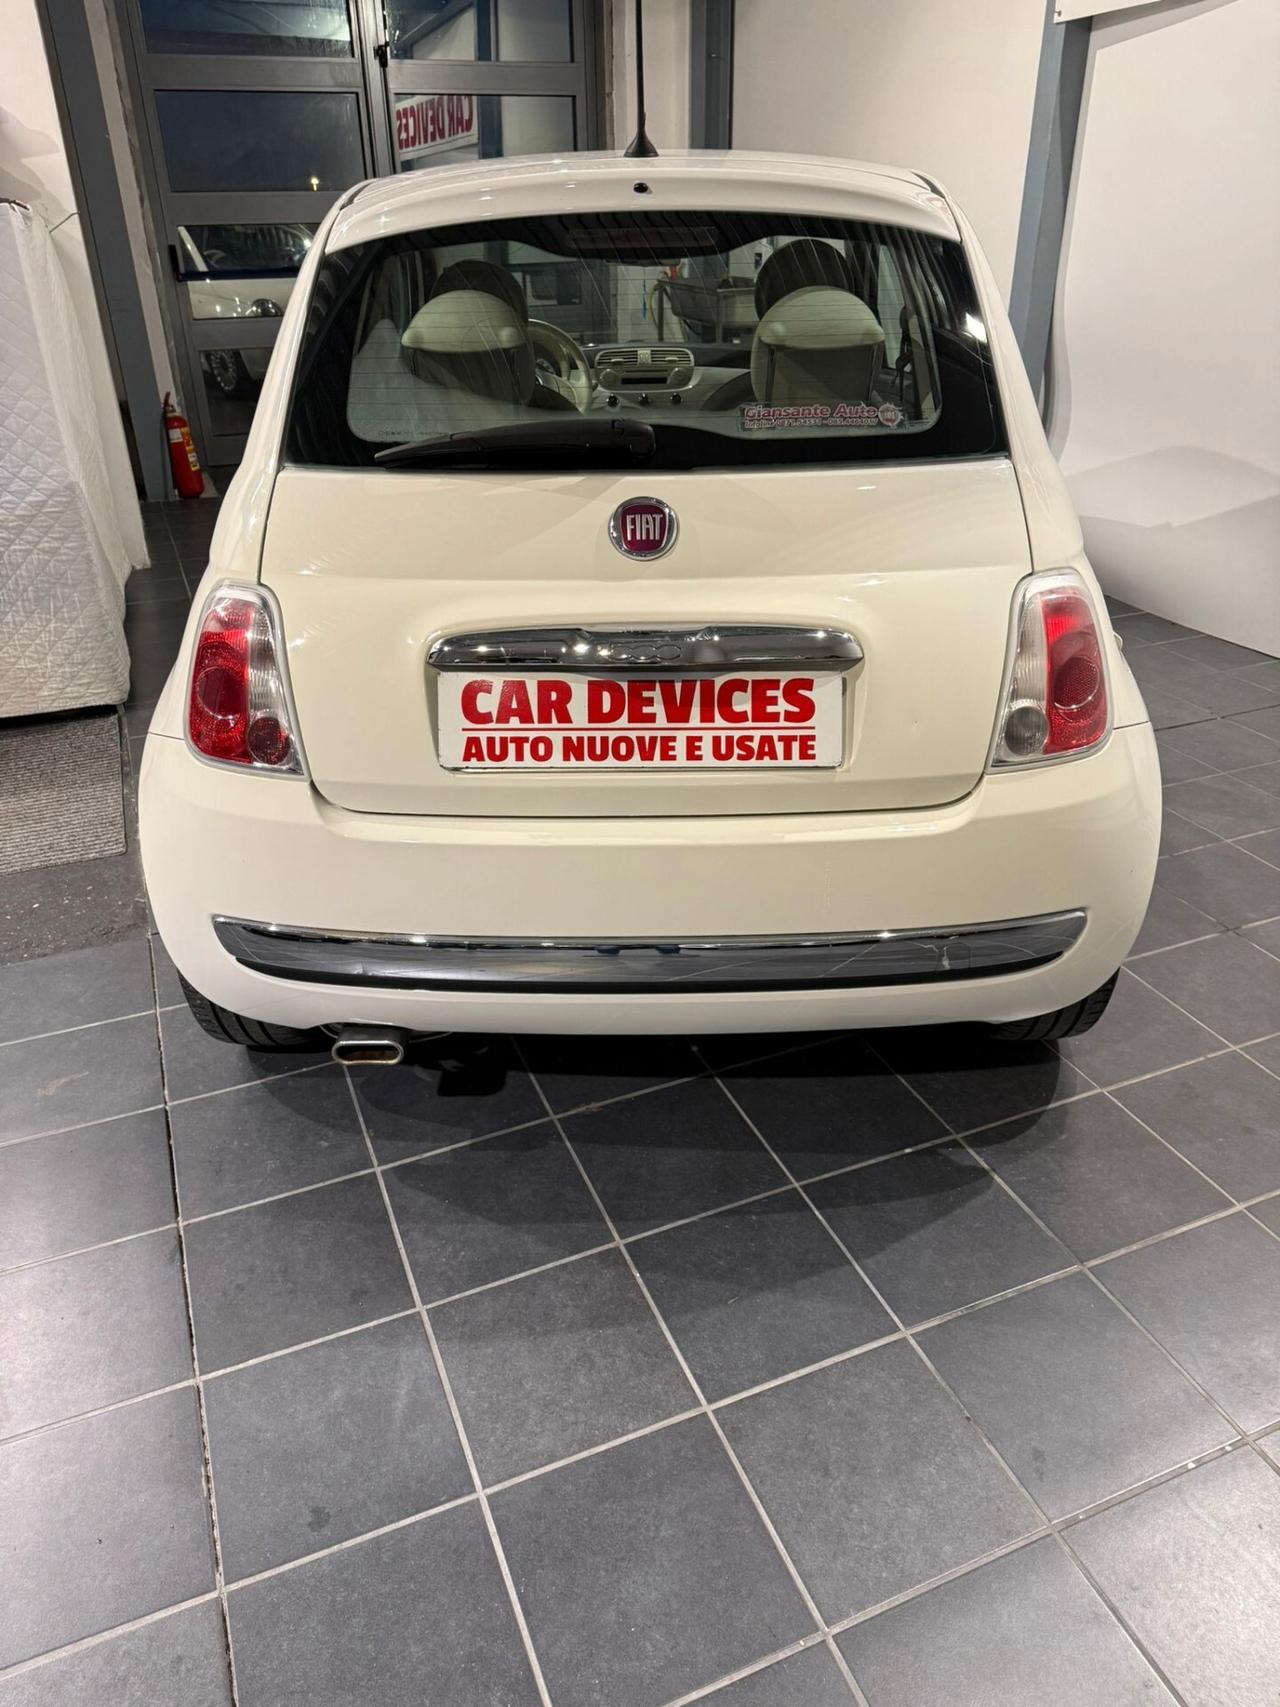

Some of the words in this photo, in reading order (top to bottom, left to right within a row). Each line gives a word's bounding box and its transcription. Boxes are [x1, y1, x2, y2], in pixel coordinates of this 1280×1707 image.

[744, 403, 831, 420] Giansante
[833, 403, 879, 418] Auto
[626, 513, 663, 541] FIAT
[460, 678, 573, 725] CAR
[587, 677, 816, 725] DEVICES
[462, 736, 554, 762] AUTO
[563, 735, 677, 762] NUOVE
[685, 735, 702, 761] E
[712, 734, 816, 761] USATE
